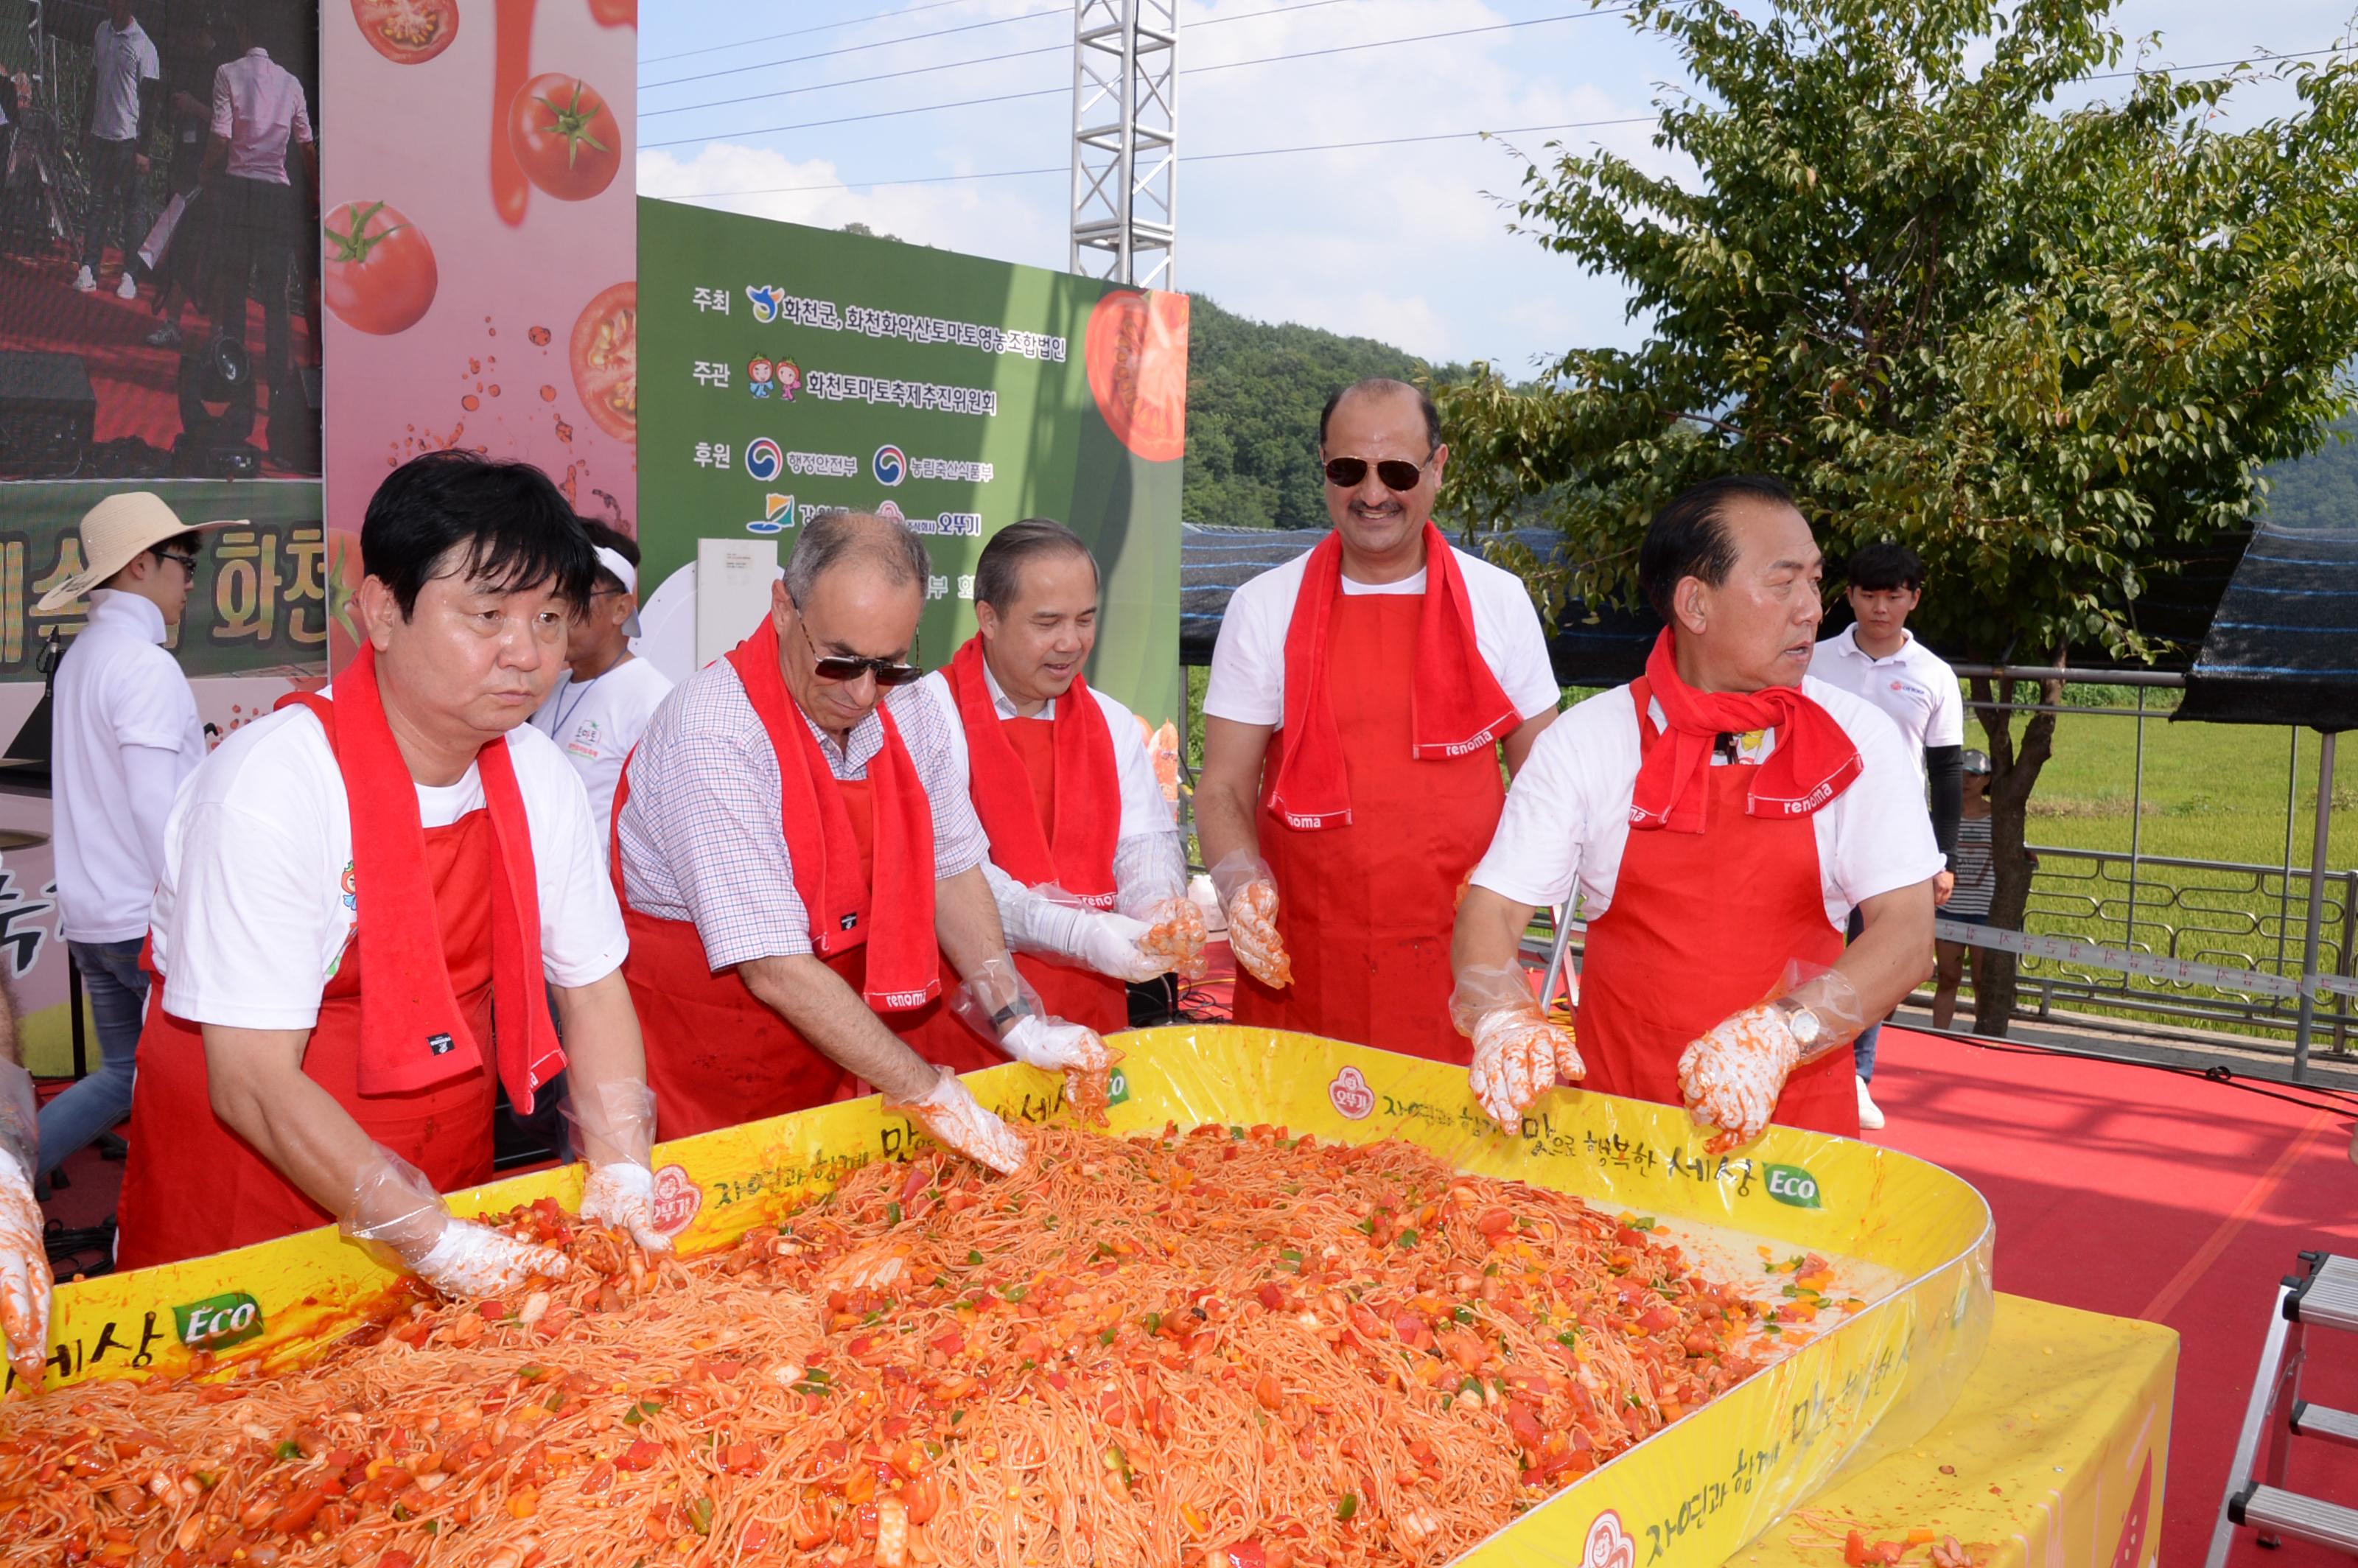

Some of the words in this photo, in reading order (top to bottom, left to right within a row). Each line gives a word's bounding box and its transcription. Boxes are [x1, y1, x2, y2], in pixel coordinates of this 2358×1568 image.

[693, 287, 730, 315] 주최
[783, 298, 843, 331] 화천군,
[846, 306, 1066, 362] 화천화악산토마토영농조합법인
[693, 361, 730, 388] 주관
[808, 372, 996, 416] 화천토마토축제추진위원회
[693, 442, 730, 469] 후원
[788, 452, 857, 476] 행정안전부
[910, 458, 993, 481] 농림축산식품부
[938, 513, 981, 536] 오뚜기
[1446, 730, 1494, 757] renoma
[1784, 783, 1833, 814] renoma
[1287, 816, 1321, 828] noma
[1082, 895, 1113, 907] reno
[1336, 1090, 1367, 1109] 오뚜기
[1521, 1113, 1576, 1158] 맛으로
[1584, 1130, 1657, 1177] 행복한
[1668, 1147, 1757, 1197] 세상
[1646, 1483, 1729, 1568] 자연과
